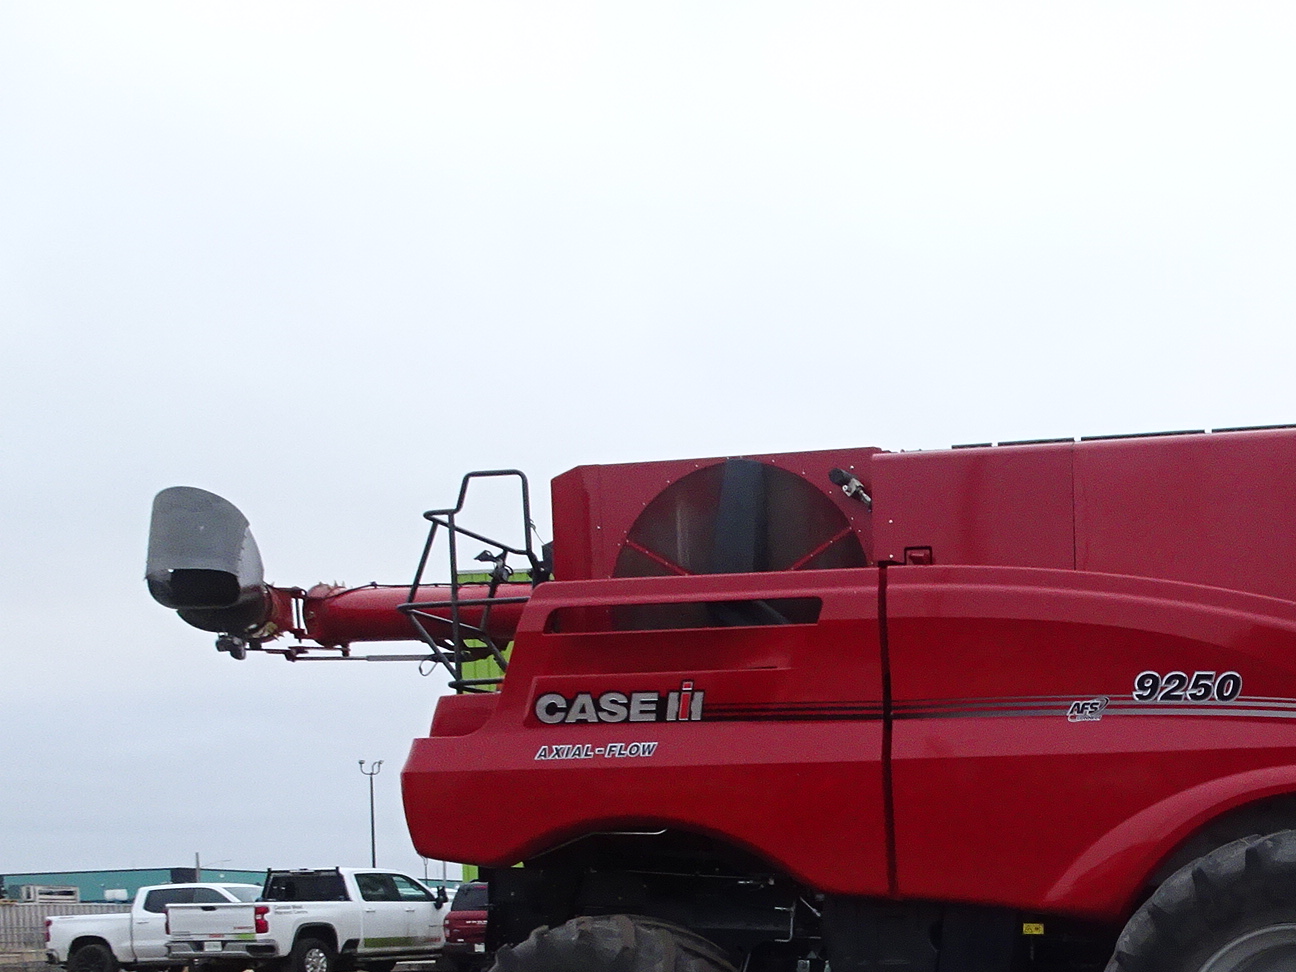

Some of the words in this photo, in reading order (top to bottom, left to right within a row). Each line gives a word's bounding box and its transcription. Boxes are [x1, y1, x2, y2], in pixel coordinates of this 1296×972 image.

[1132, 670, 1242, 702] 9250
[535, 692, 659, 724] CASE
[1067, 701, 1101, 715] AFS
[534, 742, 658, 760] AXIAL-FLOW
